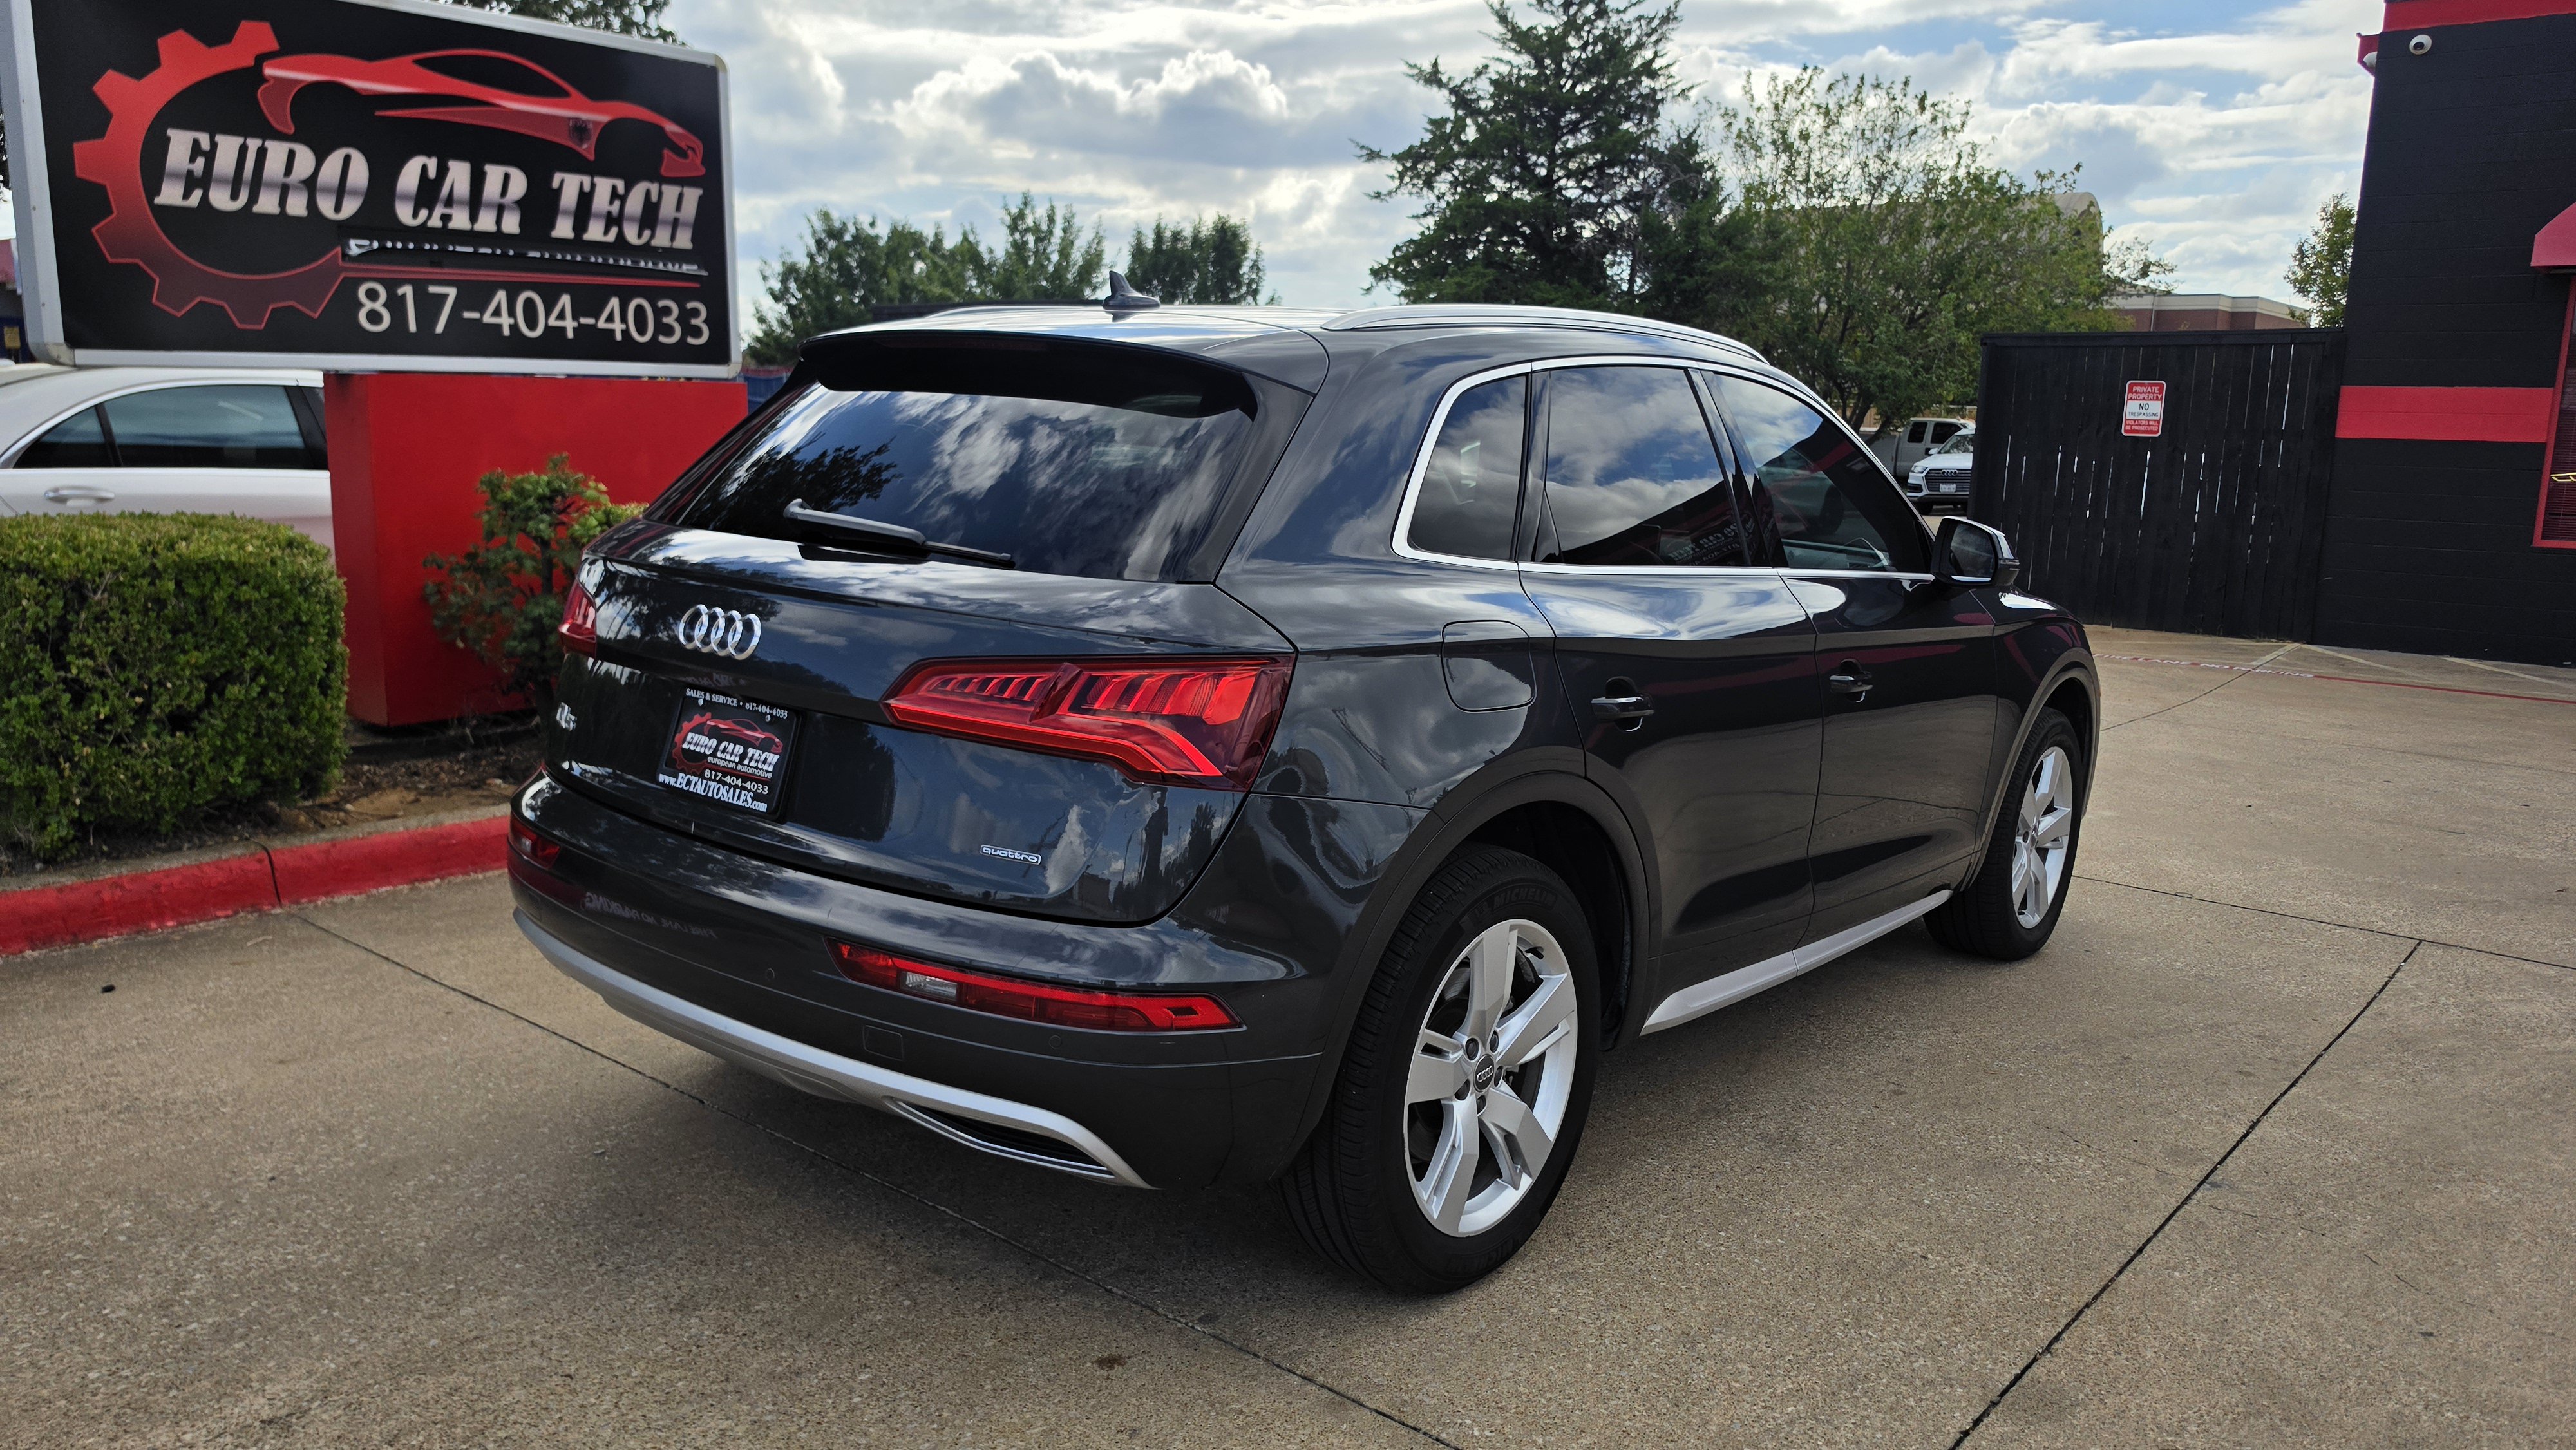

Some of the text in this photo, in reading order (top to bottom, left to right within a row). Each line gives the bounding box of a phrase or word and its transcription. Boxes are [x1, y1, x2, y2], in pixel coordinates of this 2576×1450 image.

[154, 127, 703, 250] EURO CAR TECH
[357, 280, 709, 345] 817-404-4033
[686, 688, 705, 699] SALES
[705, 692, 711, 701] &
[712, 694, 738, 707] SERVICE
[556, 702, 577, 731] Q5
[681, 731, 781, 771] EURO CAR TECH
[707, 756, 773, 779] european automotive
[658, 772, 768, 813] www.ECTAUTOSALES.com
[704, 769, 769, 795] 817-404-4033
[982, 847, 1037, 862] quattro
[1493, 887, 1556, 909] MICHELIN
